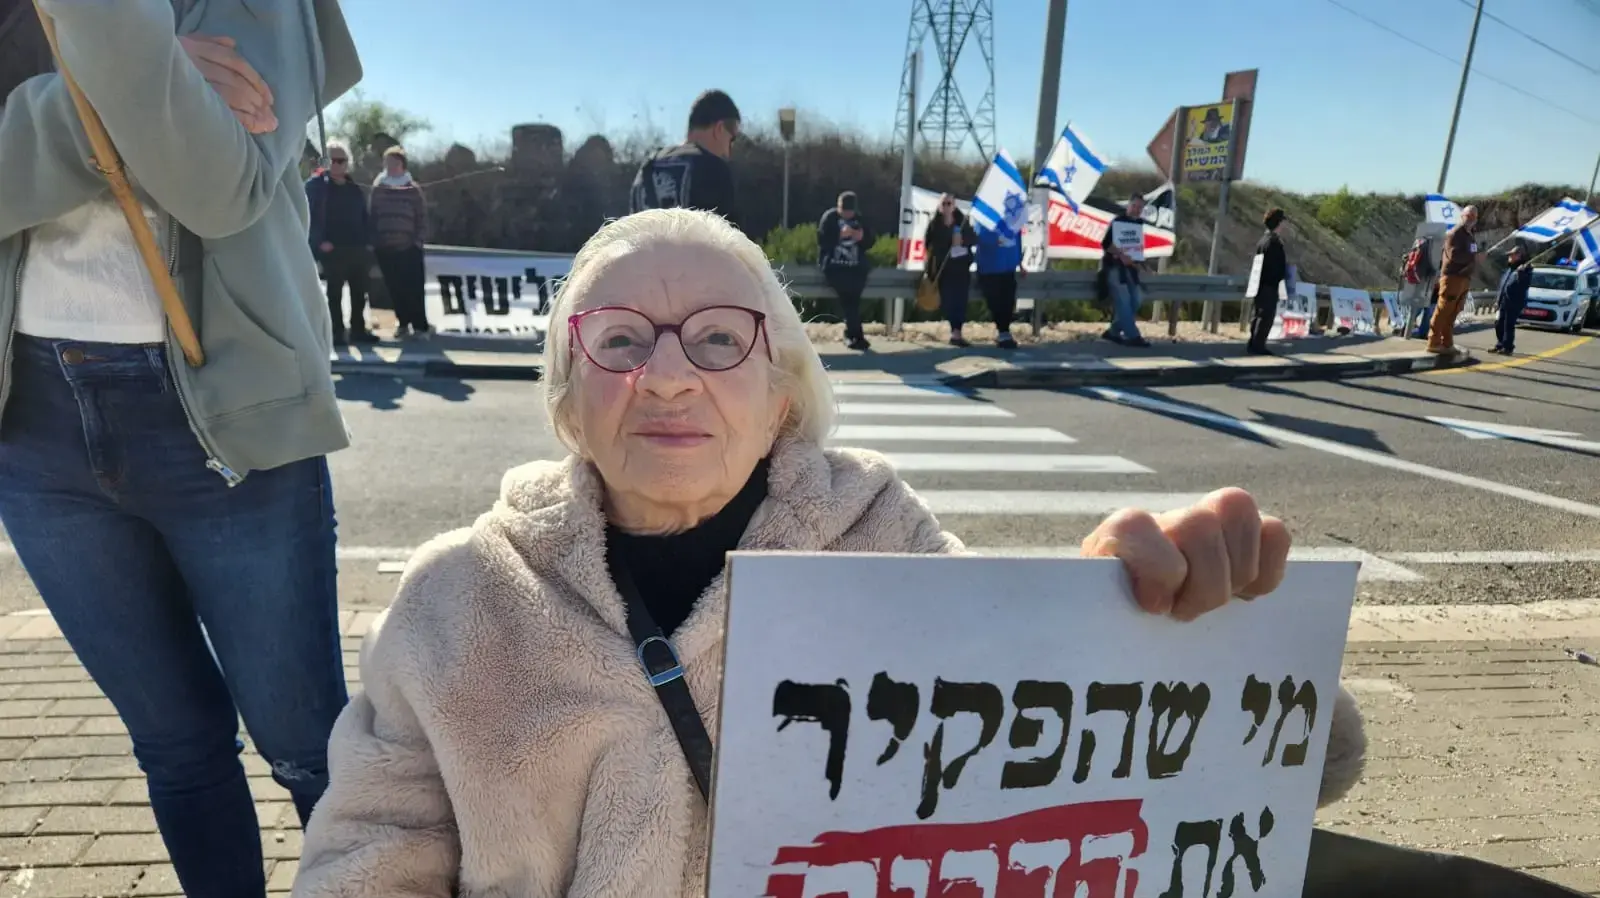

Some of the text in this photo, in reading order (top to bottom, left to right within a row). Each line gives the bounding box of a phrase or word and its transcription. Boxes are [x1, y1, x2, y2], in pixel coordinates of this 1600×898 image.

[1185, 156, 1228, 168] המשיח
[437, 267, 566, 316] ליטים
[772, 671, 1318, 819] מי שהפקיר
[1160, 805, 1275, 898] את
